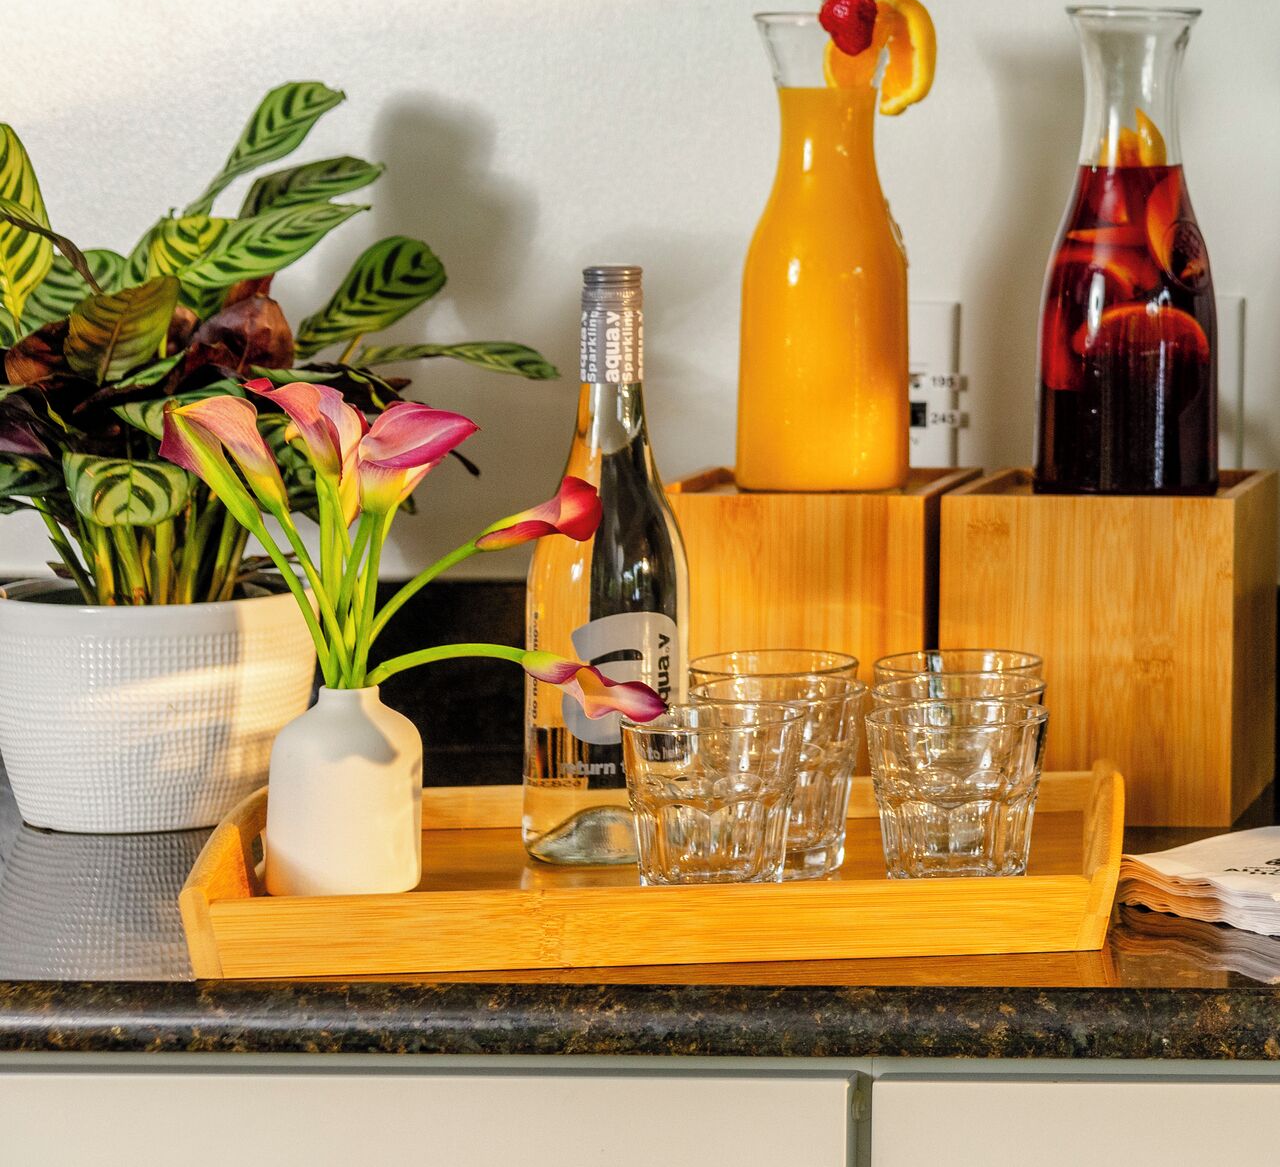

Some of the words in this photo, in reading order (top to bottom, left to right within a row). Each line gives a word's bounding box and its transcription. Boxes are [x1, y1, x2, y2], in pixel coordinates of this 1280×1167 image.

[605, 311, 623, 383] aqua.v
[657, 633, 671, 709] qua.v
[560, 761, 616, 775] return
